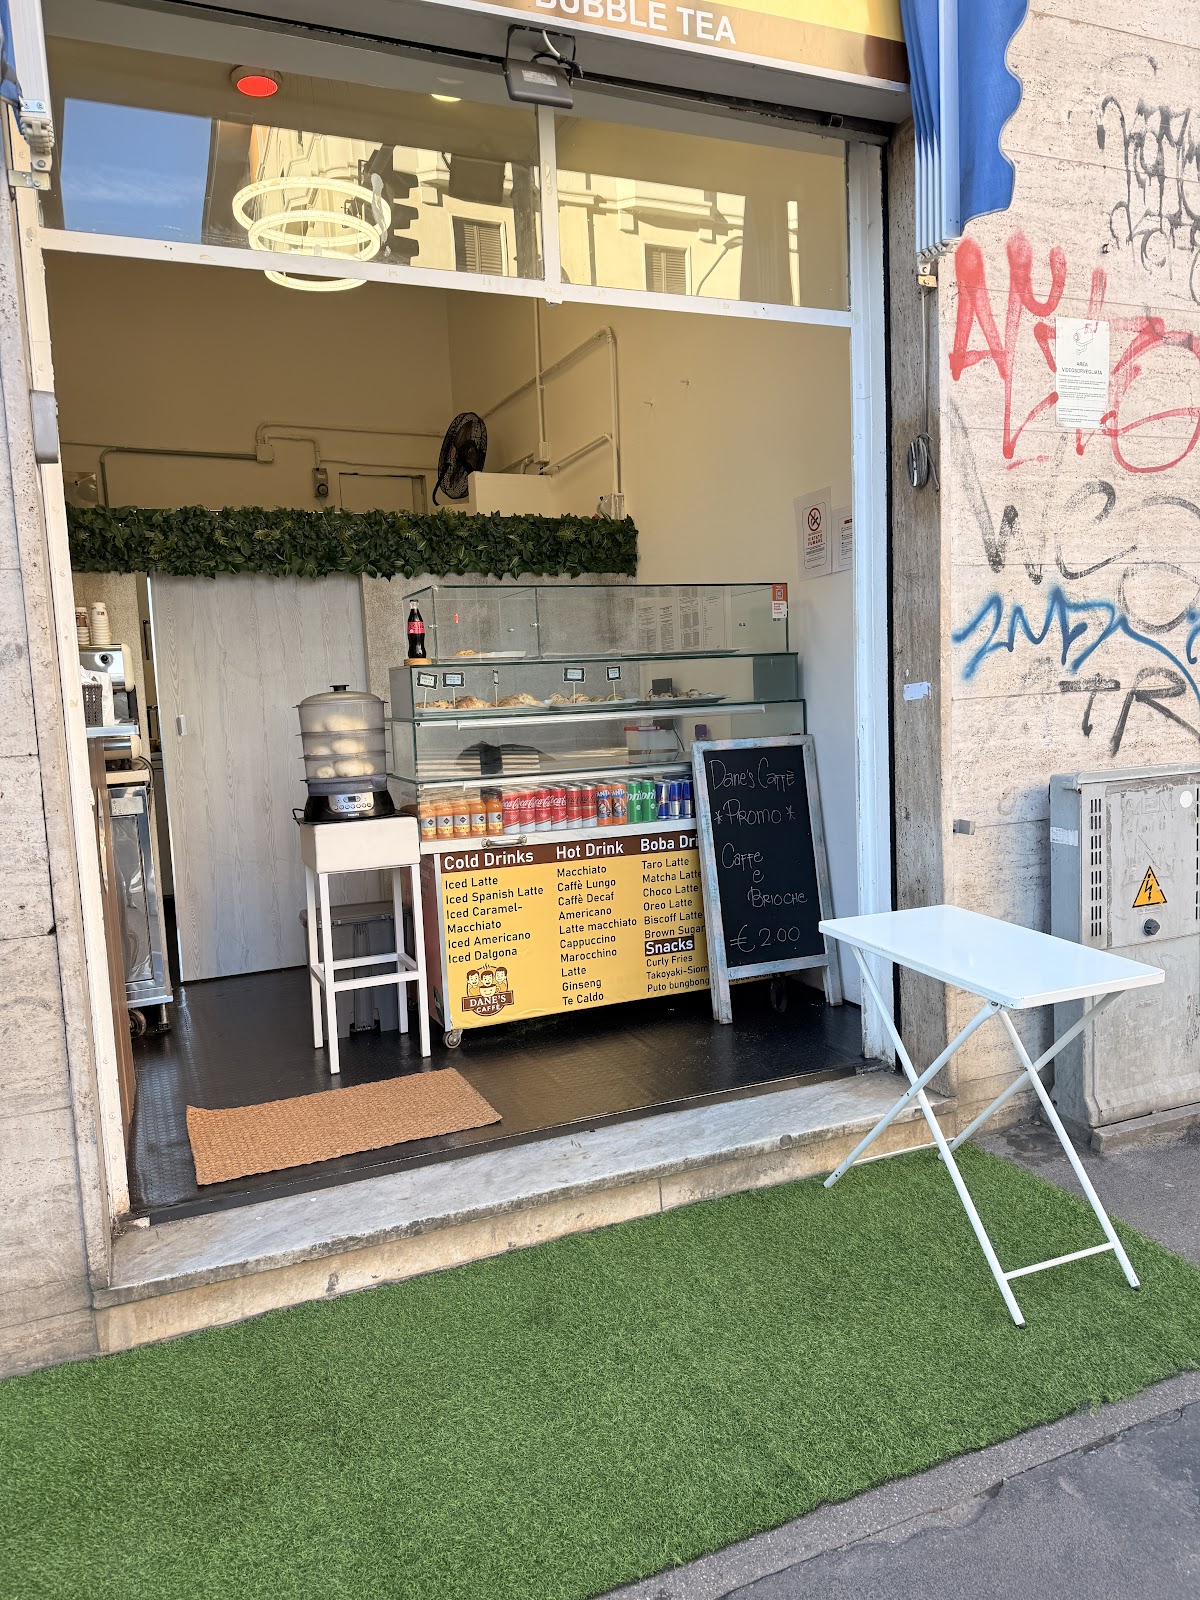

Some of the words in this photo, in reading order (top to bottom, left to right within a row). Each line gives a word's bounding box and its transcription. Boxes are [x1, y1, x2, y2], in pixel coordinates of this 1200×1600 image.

[675, 6, 737, 45] TEA
[708, 759, 755, 791] Dane's
[556, 845, 581, 860] Hot
[585, 841, 624, 857] Drink
[640, 836, 675, 852] Boba
[679, 834, 699, 849] Dri
[444, 853, 479, 870] Cold
[484, 850, 534, 867] Drinks
[641, 860, 663, 870] Taro
[665, 857, 690, 868] Latte
[557, 865, 607, 878] Macchiato
[642, 873, 677, 884] Matcha
[679, 870, 702, 880] Latte
[445, 878, 468, 890] Iced
[471, 876, 499, 887] Latte
[557, 879, 583, 892] Caffè
[586, 879, 616, 889] Lungo
[642, 887, 672, 897] Choco
[675, 884, 699, 894] Latte
[446, 893, 468, 905] Iced
[472, 888, 514, 904] Spanish
[517, 886, 544, 897] Latte
[558, 893, 583, 906] Caffè
[586, 891, 614, 903] Decaf
[446, 908, 469, 919] Iced
[472, 902, 523, 917] Caramel-
[643, 902, 666, 911] Oreo
[669, 898, 693, 909] Latte
[558, 907, 612, 921] Americano
[644, 912, 677, 925] Biscoff
[679, 911, 703, 921] Latte
[447, 920, 502, 934] Macchiato
[559, 924, 585, 935] Latte
[587, 918, 637, 931] macchiato
[644, 928, 675, 939] Brown
[678, 925, 706, 936] Sugar
[448, 937, 470, 949] Iced
[473, 932, 531, 946] Americano
[560, 934, 616, 949] Cappuccino
[758, 926, 800, 947] 2.00
[645, 937, 694, 955] Snacks
[448, 952, 471, 963] Iced
[474, 948, 518, 961] Dalgona
[560, 948, 617, 963] Marocchino
[646, 957, 669, 967] Curly
[671, 954, 693, 964] Fries
[561, 966, 587, 977] Latte
[646, 965, 709, 980] Takoyaki-Siom
[562, 979, 602, 991] Ginseng
[647, 983, 667, 993] Puto
[469, 994, 507, 1008] DANE'S
[562, 996, 574, 1006] Te
[576, 991, 604, 1004] Caldo
